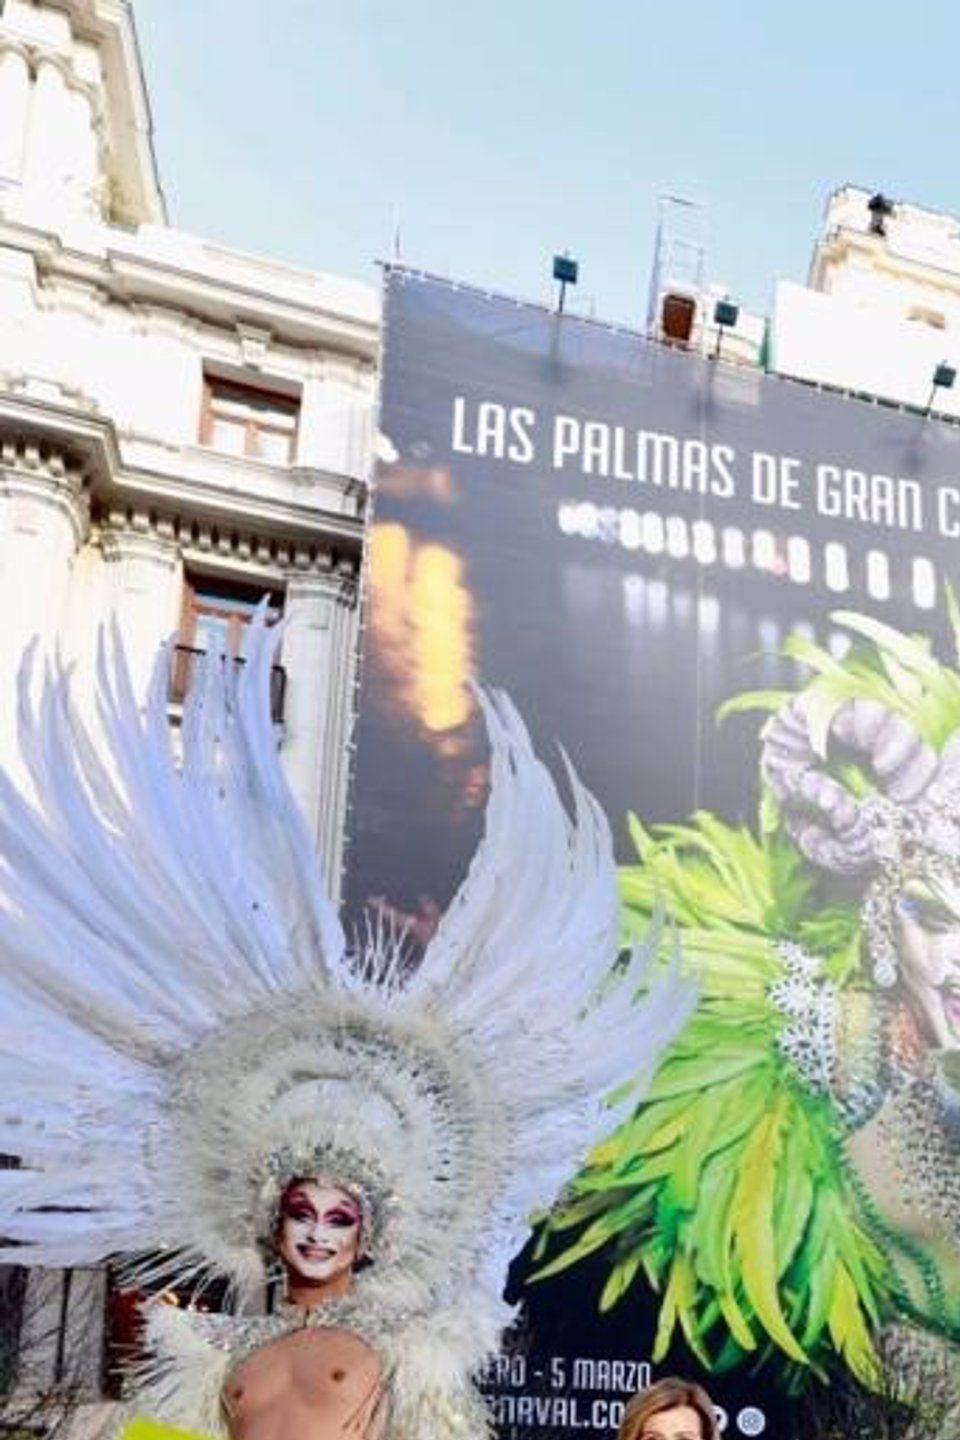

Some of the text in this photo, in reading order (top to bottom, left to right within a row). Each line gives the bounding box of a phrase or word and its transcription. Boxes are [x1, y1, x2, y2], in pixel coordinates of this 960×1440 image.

[452, 397, 535, 465] LAS
[553, 417, 735, 499] PALMAS
[753, 454, 801, 509] DE
[817, 466, 923, 531] GRAN
[550, 1356, 566, 1388] 5
[573, 1357, 651, 1393] MARZO
